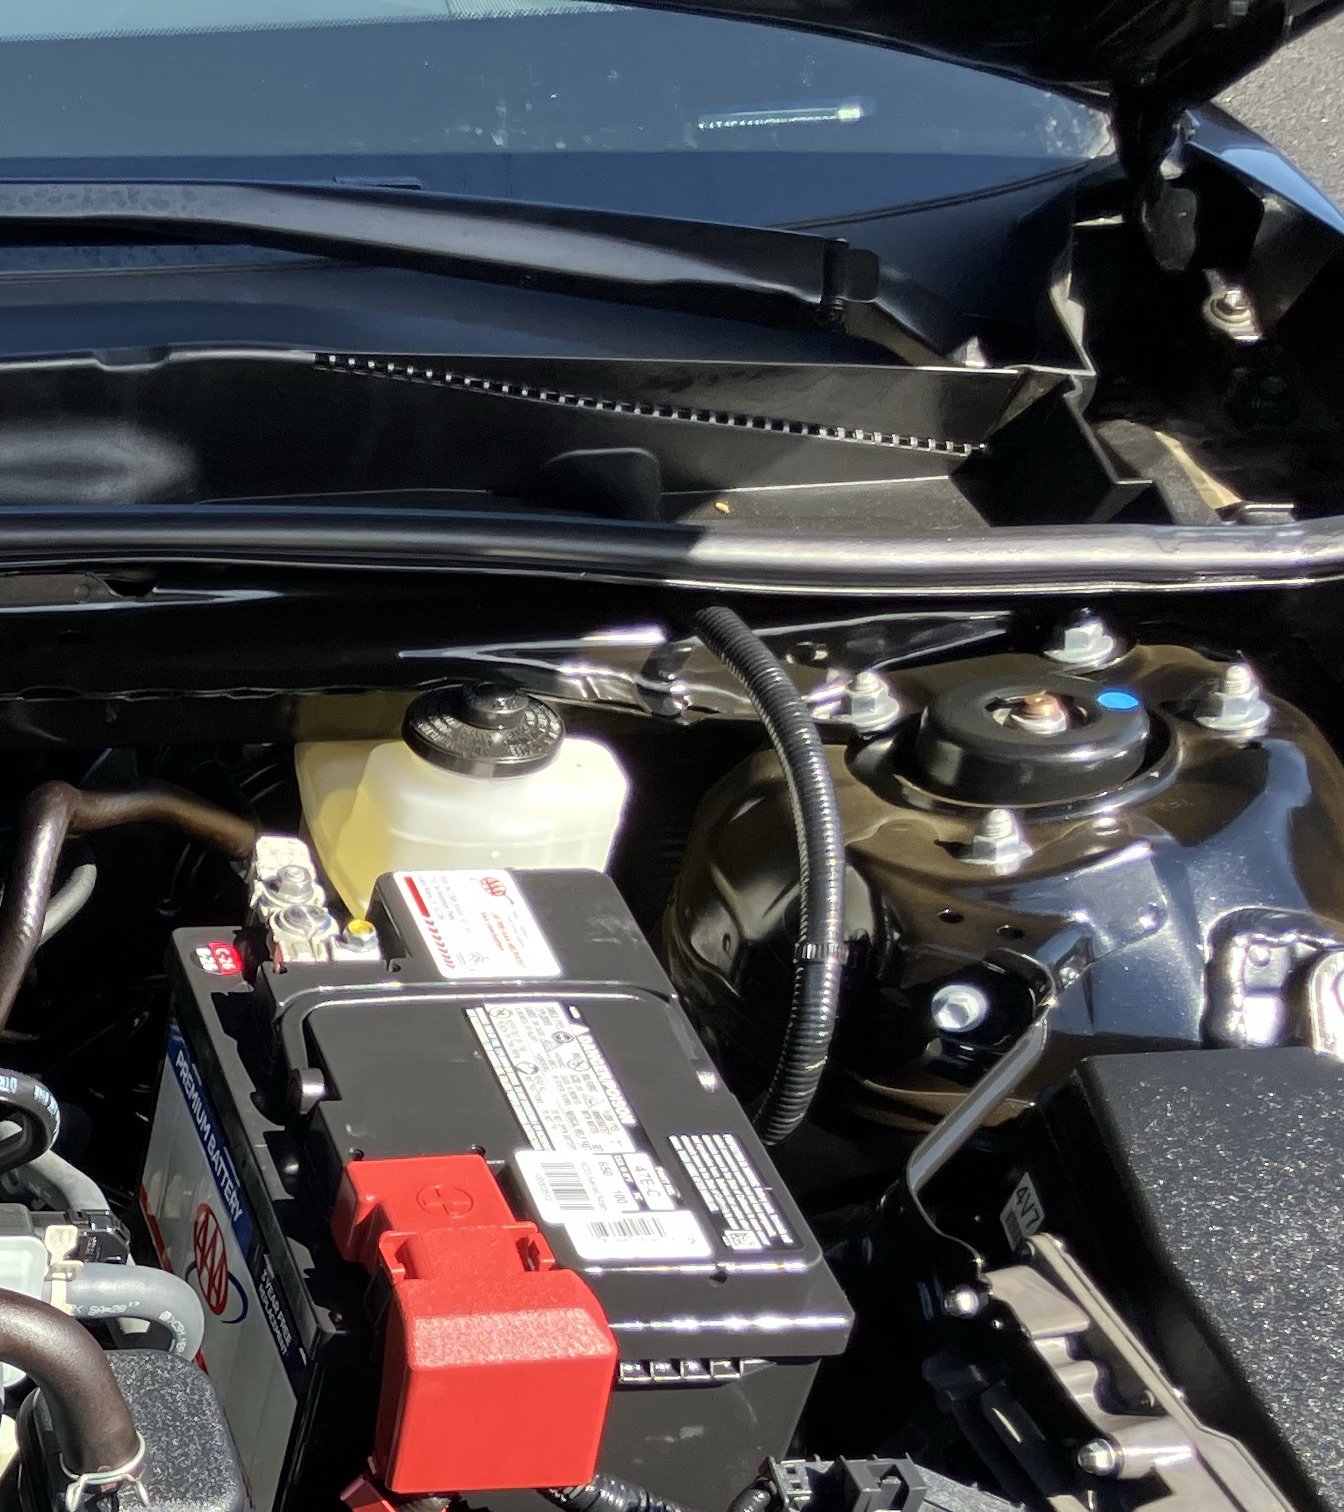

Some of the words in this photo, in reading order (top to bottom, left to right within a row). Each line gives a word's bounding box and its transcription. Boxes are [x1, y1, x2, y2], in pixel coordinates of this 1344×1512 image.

[575, 1034, 637, 1126] DANGER/POISON
[175, 1050, 212, 1142] PREMIUM
[207, 1134, 244, 1223] BATTERY
[635, 1165, 662, 1199] 47E-C
